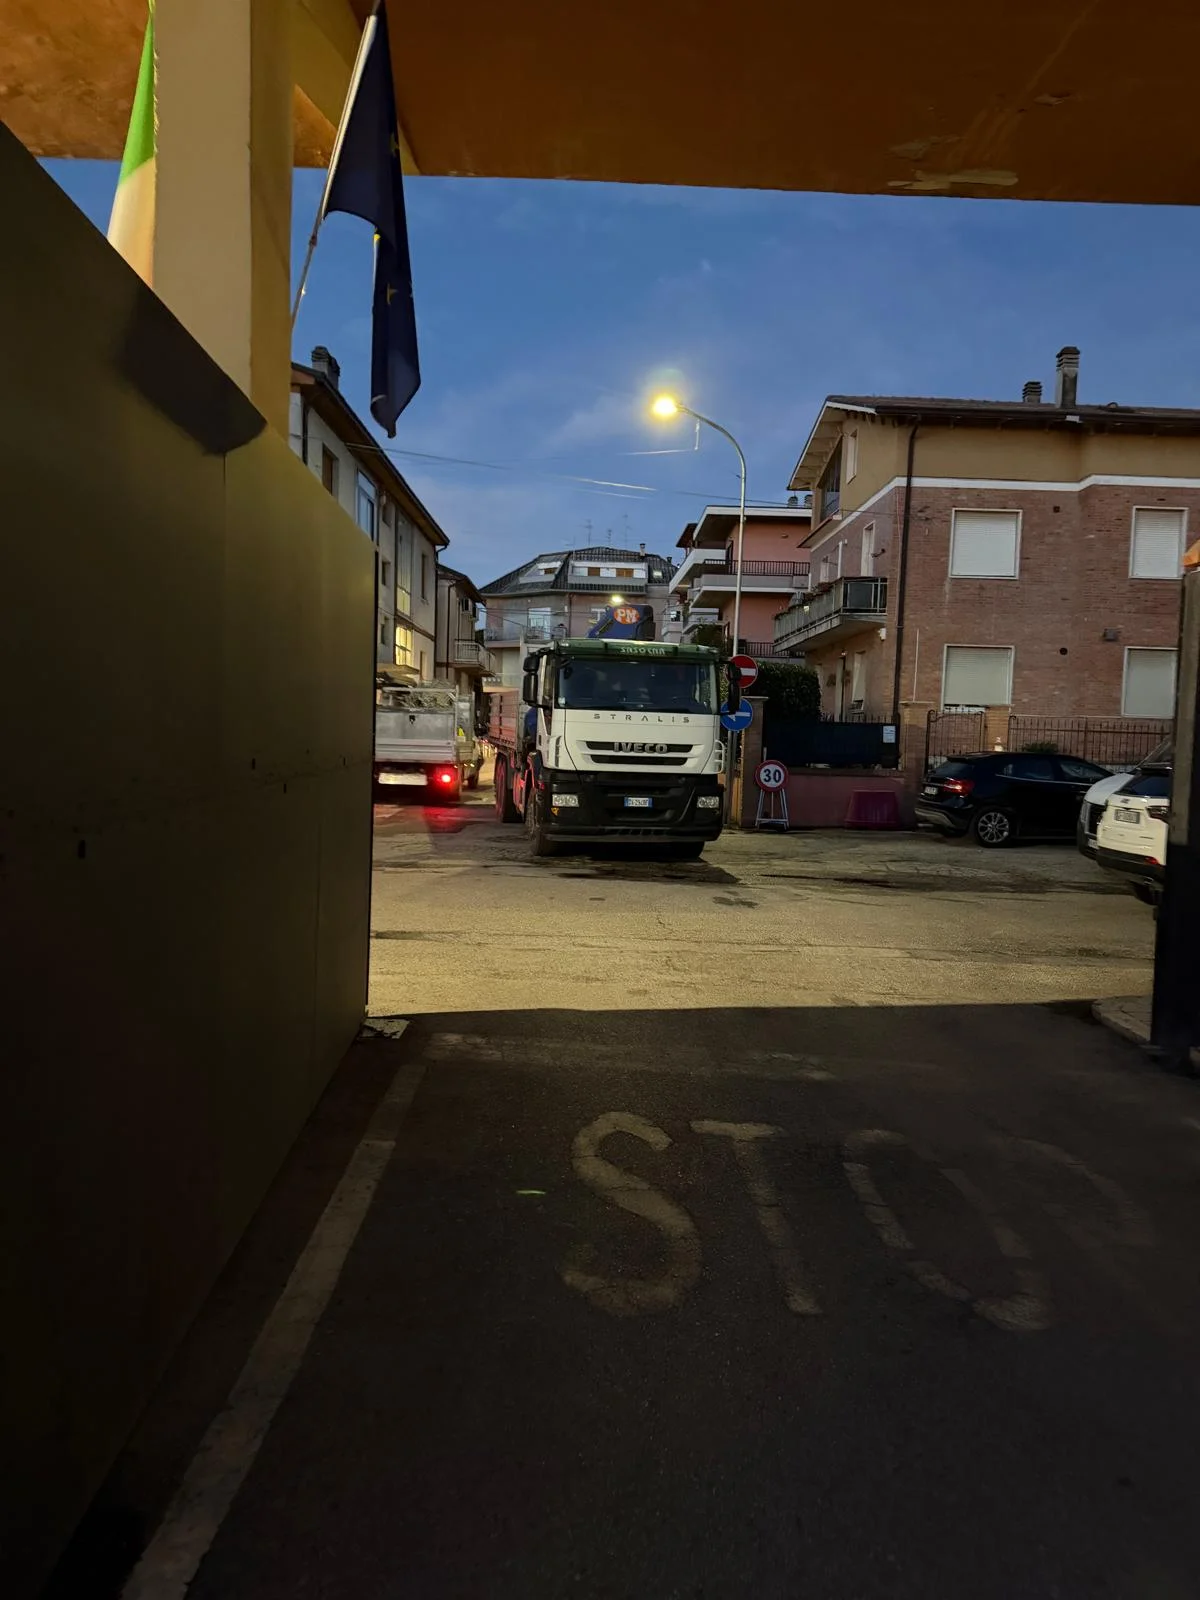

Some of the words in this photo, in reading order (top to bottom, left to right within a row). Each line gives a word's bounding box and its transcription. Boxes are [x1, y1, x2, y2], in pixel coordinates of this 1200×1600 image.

[616, 608, 637, 623] PM
[593, 713, 690, 724] STRALIS
[613, 741, 668, 754] IVECO
[763, 768, 782, 783] 30
